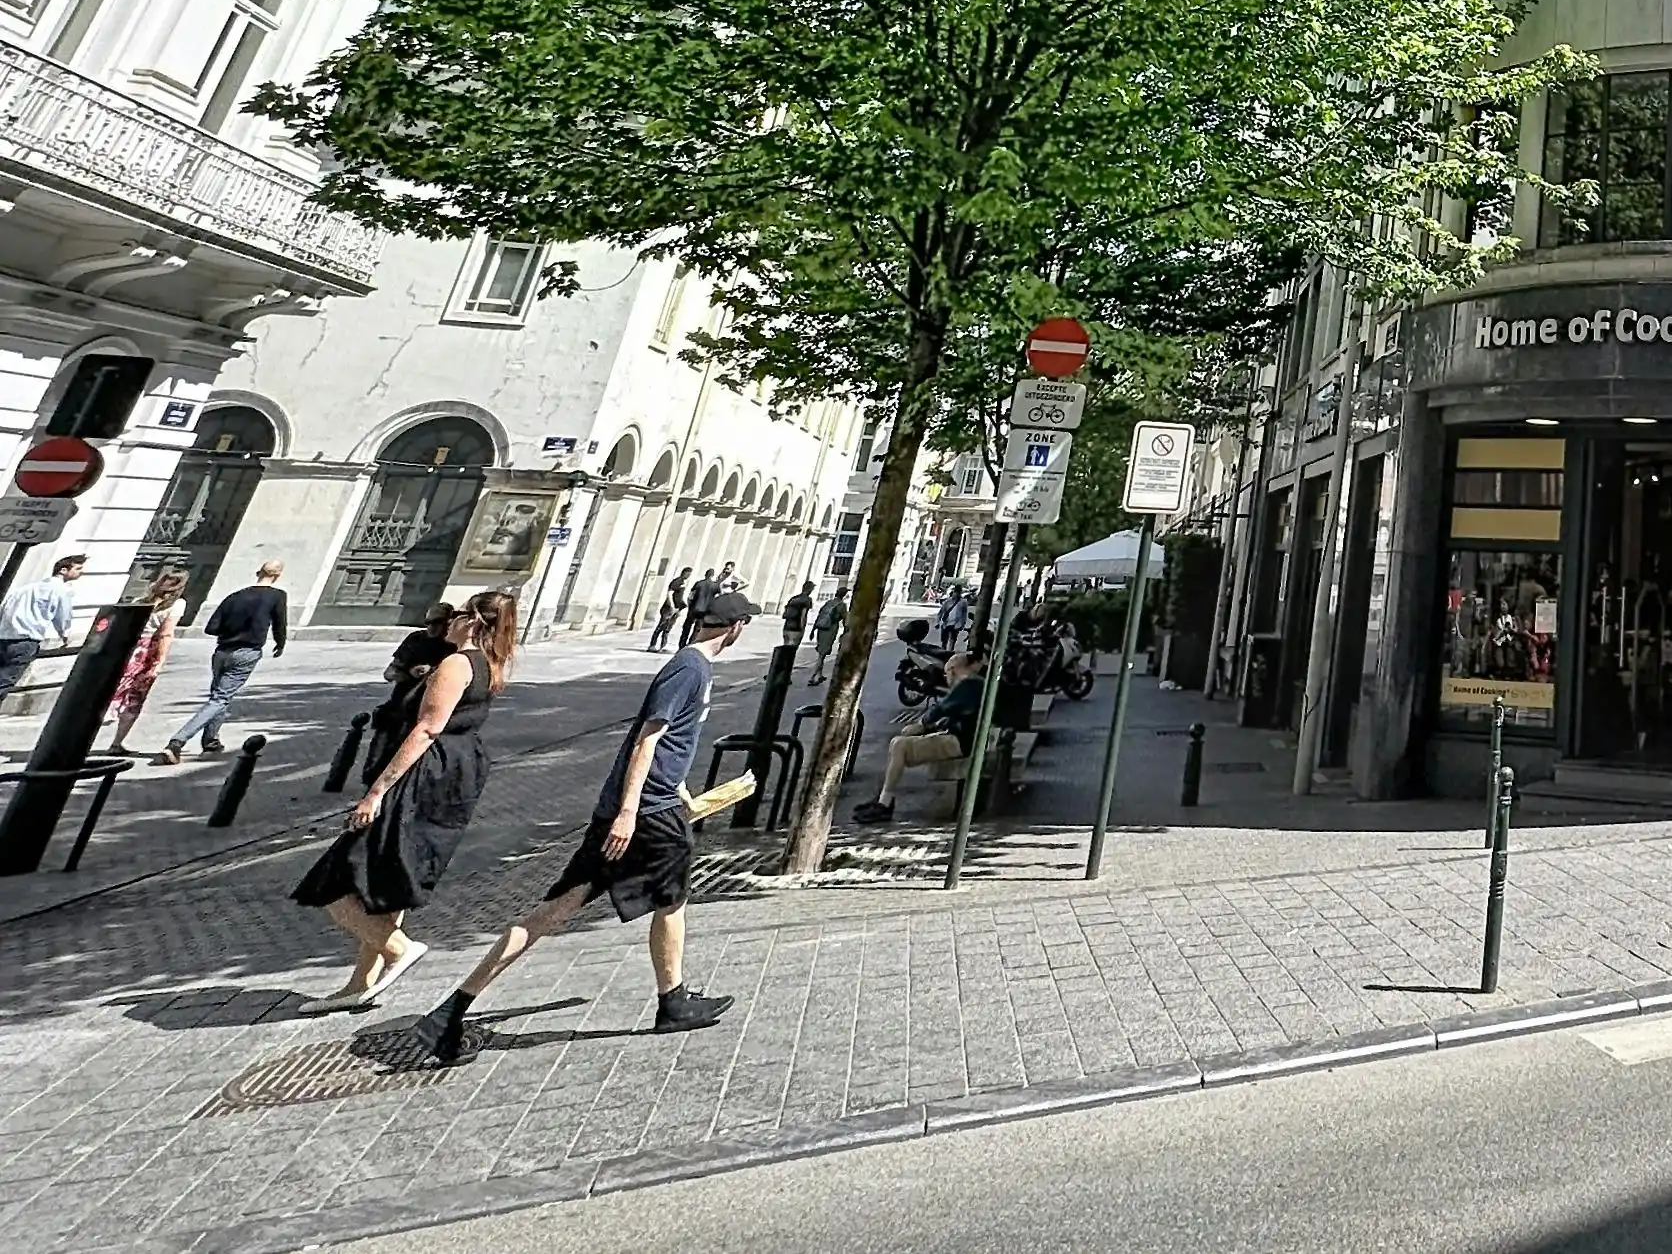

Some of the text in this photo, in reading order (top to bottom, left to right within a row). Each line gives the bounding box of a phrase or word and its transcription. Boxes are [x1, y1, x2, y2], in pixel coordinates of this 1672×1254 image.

[1475, 316, 1558, 348] Home
[1568, 309, 1612, 343] of
[1025, 432, 1057, 444] ZONE
[1453, 685, 1471, 694] Home
[1472, 686, 1480, 695] of
